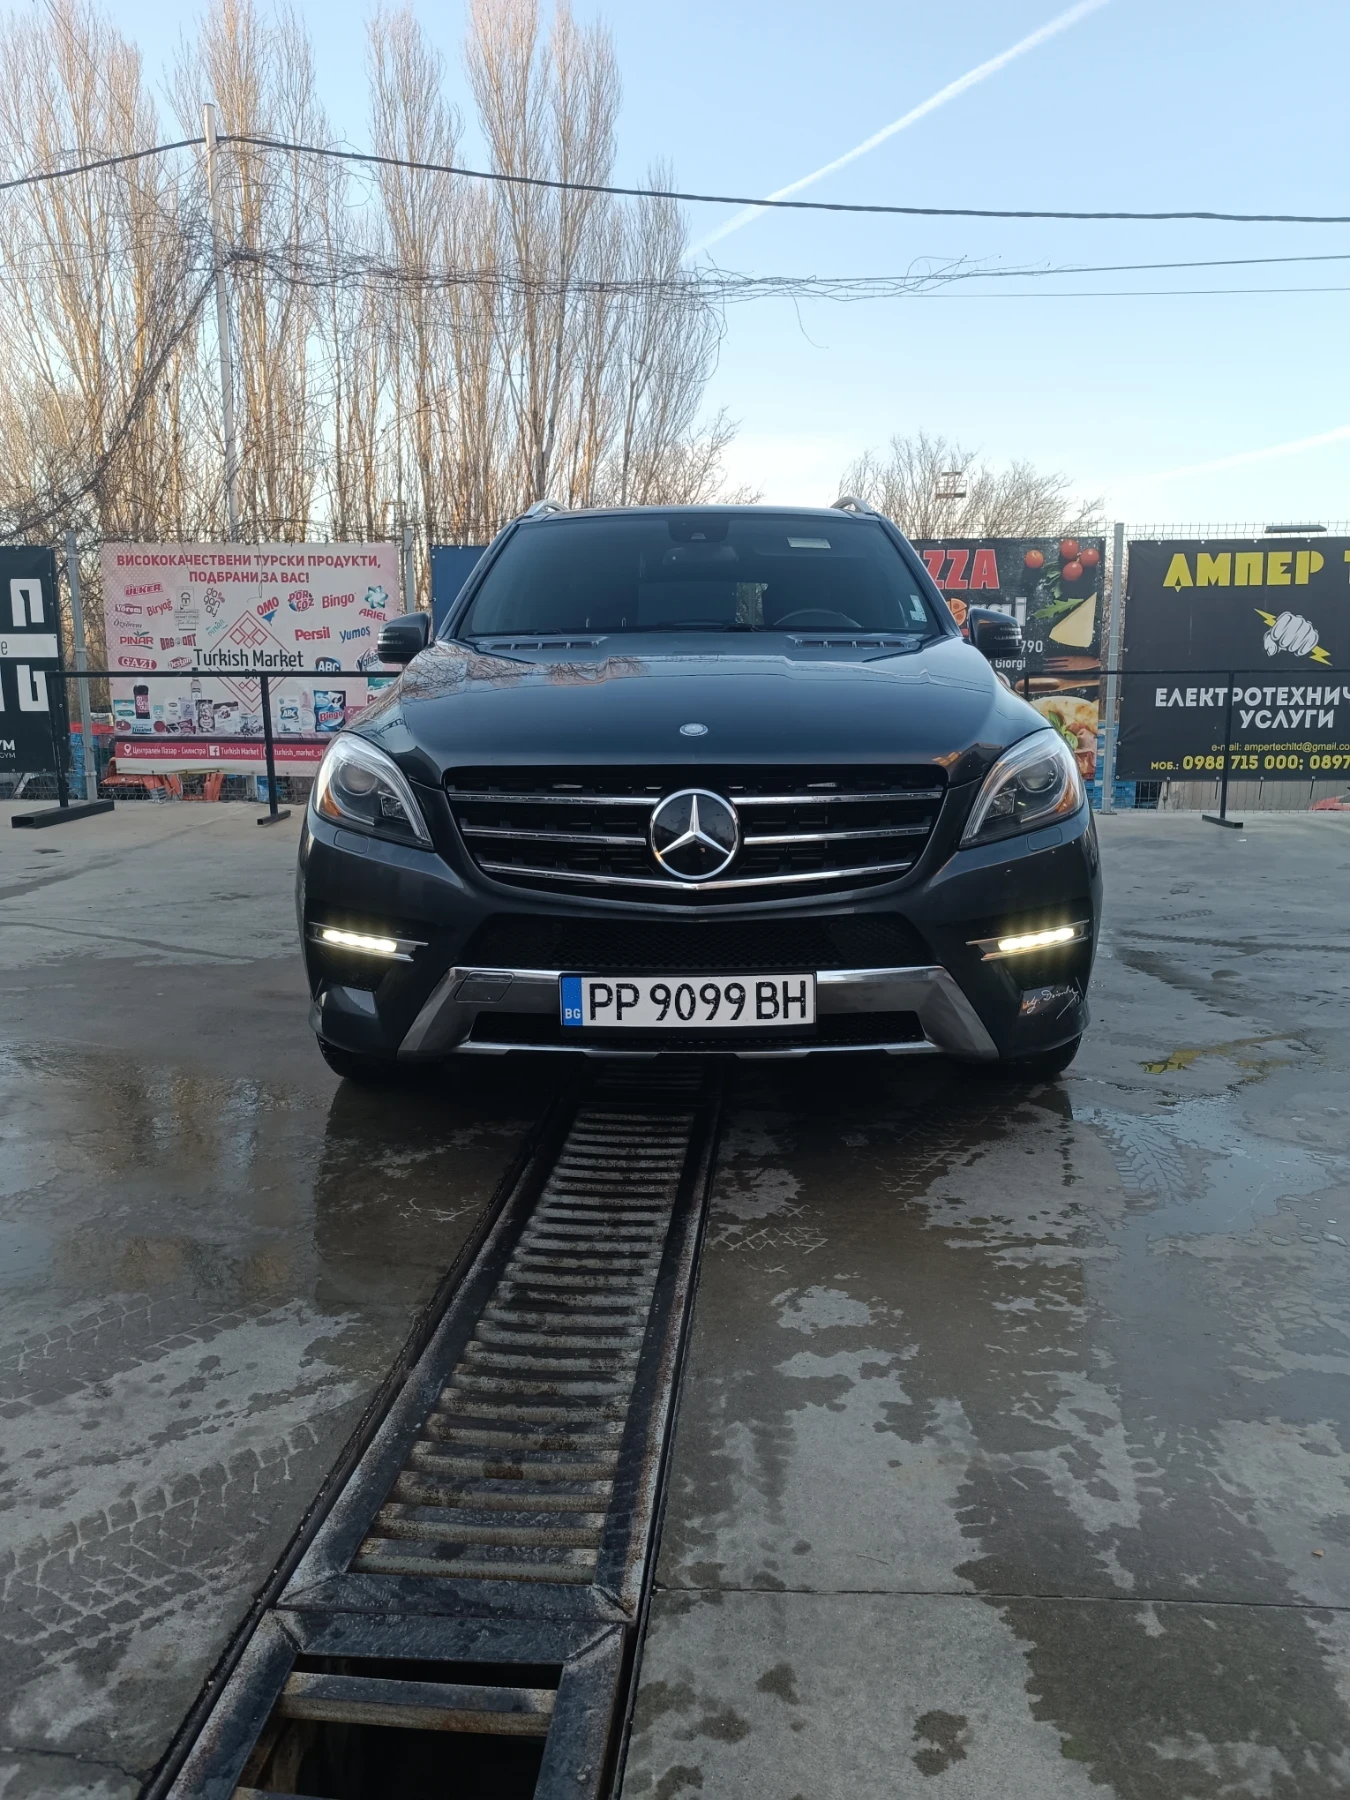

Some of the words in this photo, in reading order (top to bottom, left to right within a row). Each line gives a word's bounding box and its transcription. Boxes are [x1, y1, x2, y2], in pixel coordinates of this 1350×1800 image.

[117, 555, 251, 566] ВИСОКОКАЧЕСТВЕНИ
[254, 555, 305, 567] ТУРСКИ
[308, 555, 381, 568] ПРОДУКТИ,
[916, 549, 1000, 589] ZZA
[189, 571, 258, 584] ПОДБРАНИ
[261, 572, 278, 583] ЗА
[281, 572, 309, 583] ВАС!
[1163, 551, 1324, 590] АМПЕР
[256, 596, 280, 616] OMO
[321, 593, 356, 609] Bingo
[359, 608, 388, 621] ARIEL
[120, 636, 154, 645] PINAR
[295, 626, 331, 641] Persil
[193, 649, 249, 667] Turkish
[253, 649, 304, 668] Market
[318, 660, 340, 672] ABC
[356, 652, 379, 672] Vanis
[995, 657, 1026, 671] Giorgi
[1239, 709, 1334, 729] УСЛУГИ
[274, 749, 324, 757] turkish_market_sil
[1182, 755, 1225, 770] 0988
[1231, 755, 1258, 769] 715
[1264, 755, 1303, 770] 000;
[1309, 755, 1350, 769] 0897
[589, 983, 640, 1021] PP
[650, 982, 746, 1021] 9099
[756, 981, 806, 1019] BH
[565, 1008, 581, 1019] BG
